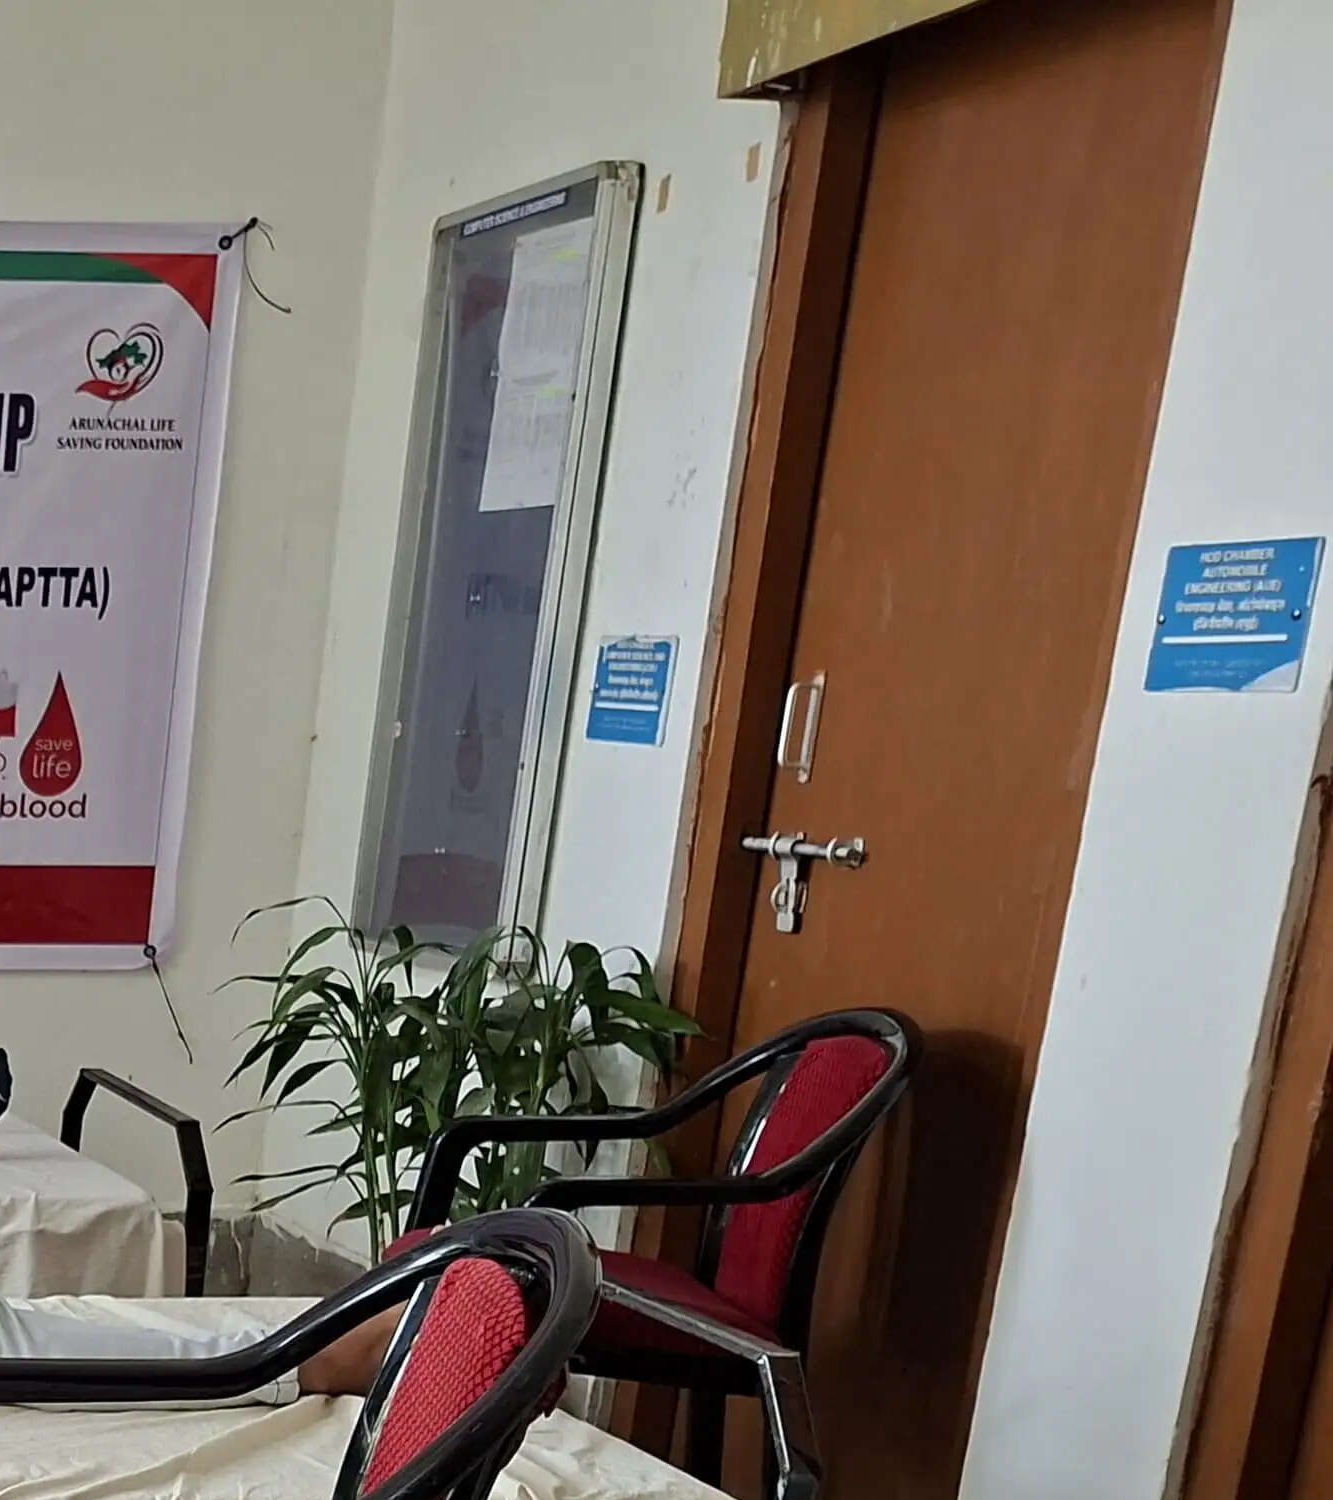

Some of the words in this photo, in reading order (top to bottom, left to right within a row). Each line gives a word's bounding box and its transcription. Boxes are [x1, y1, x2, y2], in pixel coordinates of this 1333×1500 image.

[69, 416, 148, 432] ARUNACHAL
[150, 418, 176, 432] LIFE
[56, 436, 102, 450] SAVING
[104, 437, 184, 451] FOUNDATION
[34, 738, 73, 751] save
[32, 754, 72, 779] life
[0, 793, 87, 818] blood
